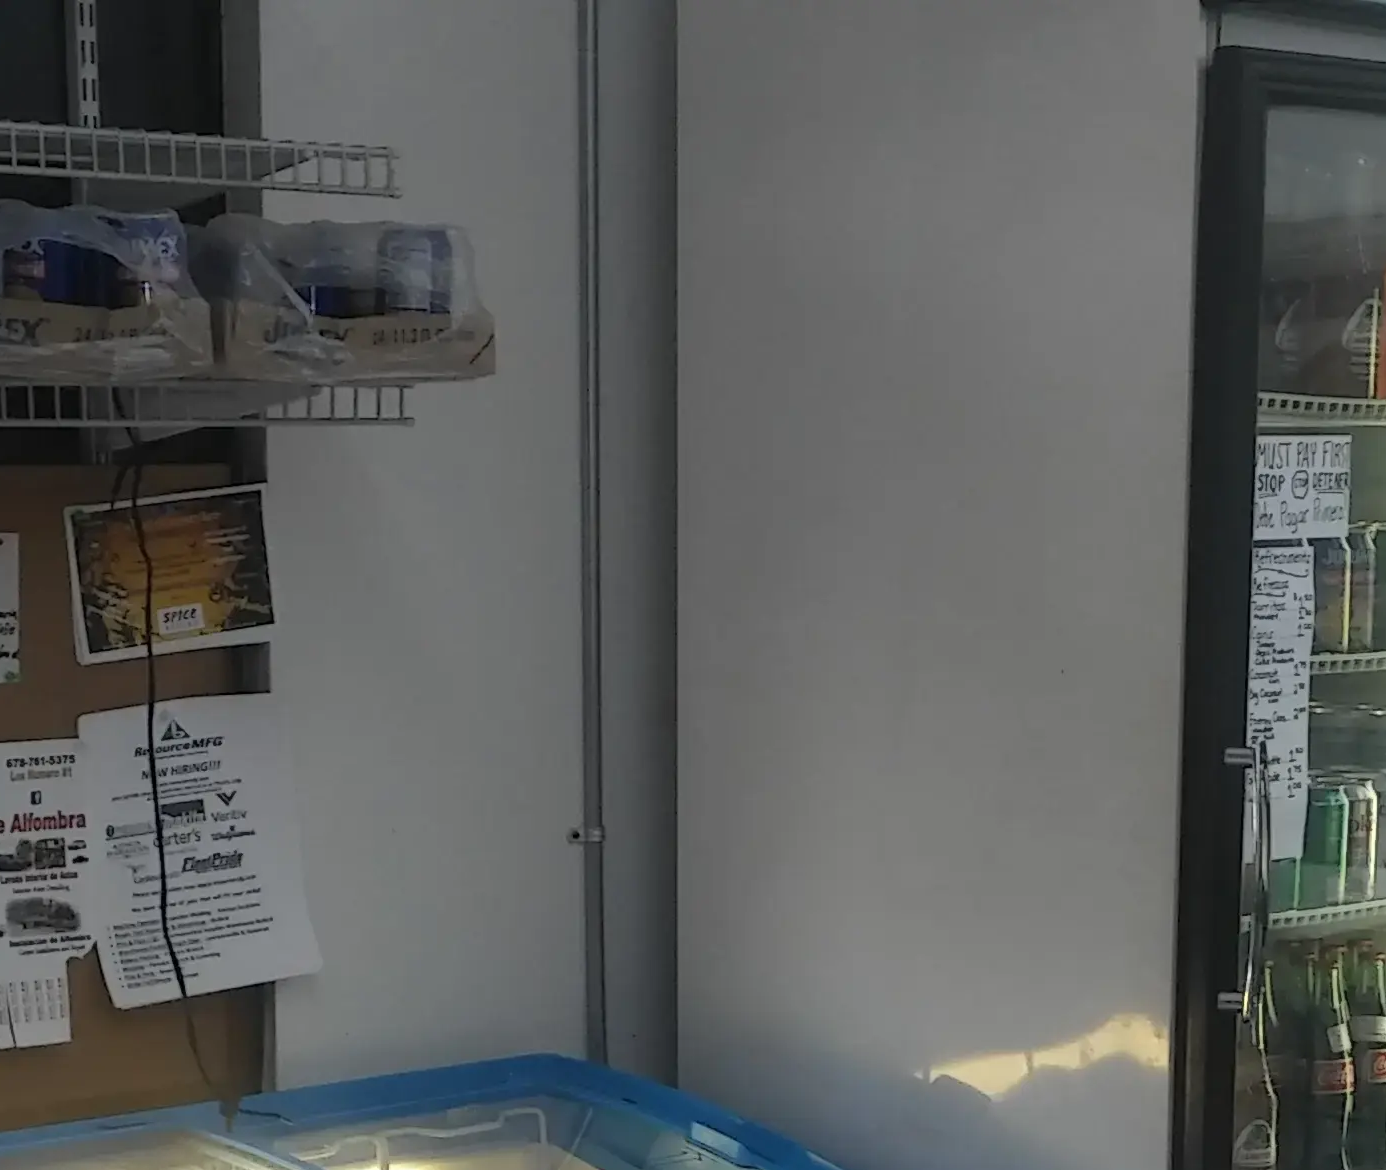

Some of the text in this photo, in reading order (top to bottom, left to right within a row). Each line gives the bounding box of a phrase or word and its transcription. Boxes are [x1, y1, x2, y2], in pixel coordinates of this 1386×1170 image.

[1256, 441, 1292, 470] MUST
[1296, 441, 1318, 469] PAY
[1257, 474, 1286, 493] STOP
[1279, 500, 1310, 534] Pagar
[134, 736, 225, 760] ReourceMFG
[141, 761, 169, 780] NW
[11, 811, 87, 834] Alfombra
